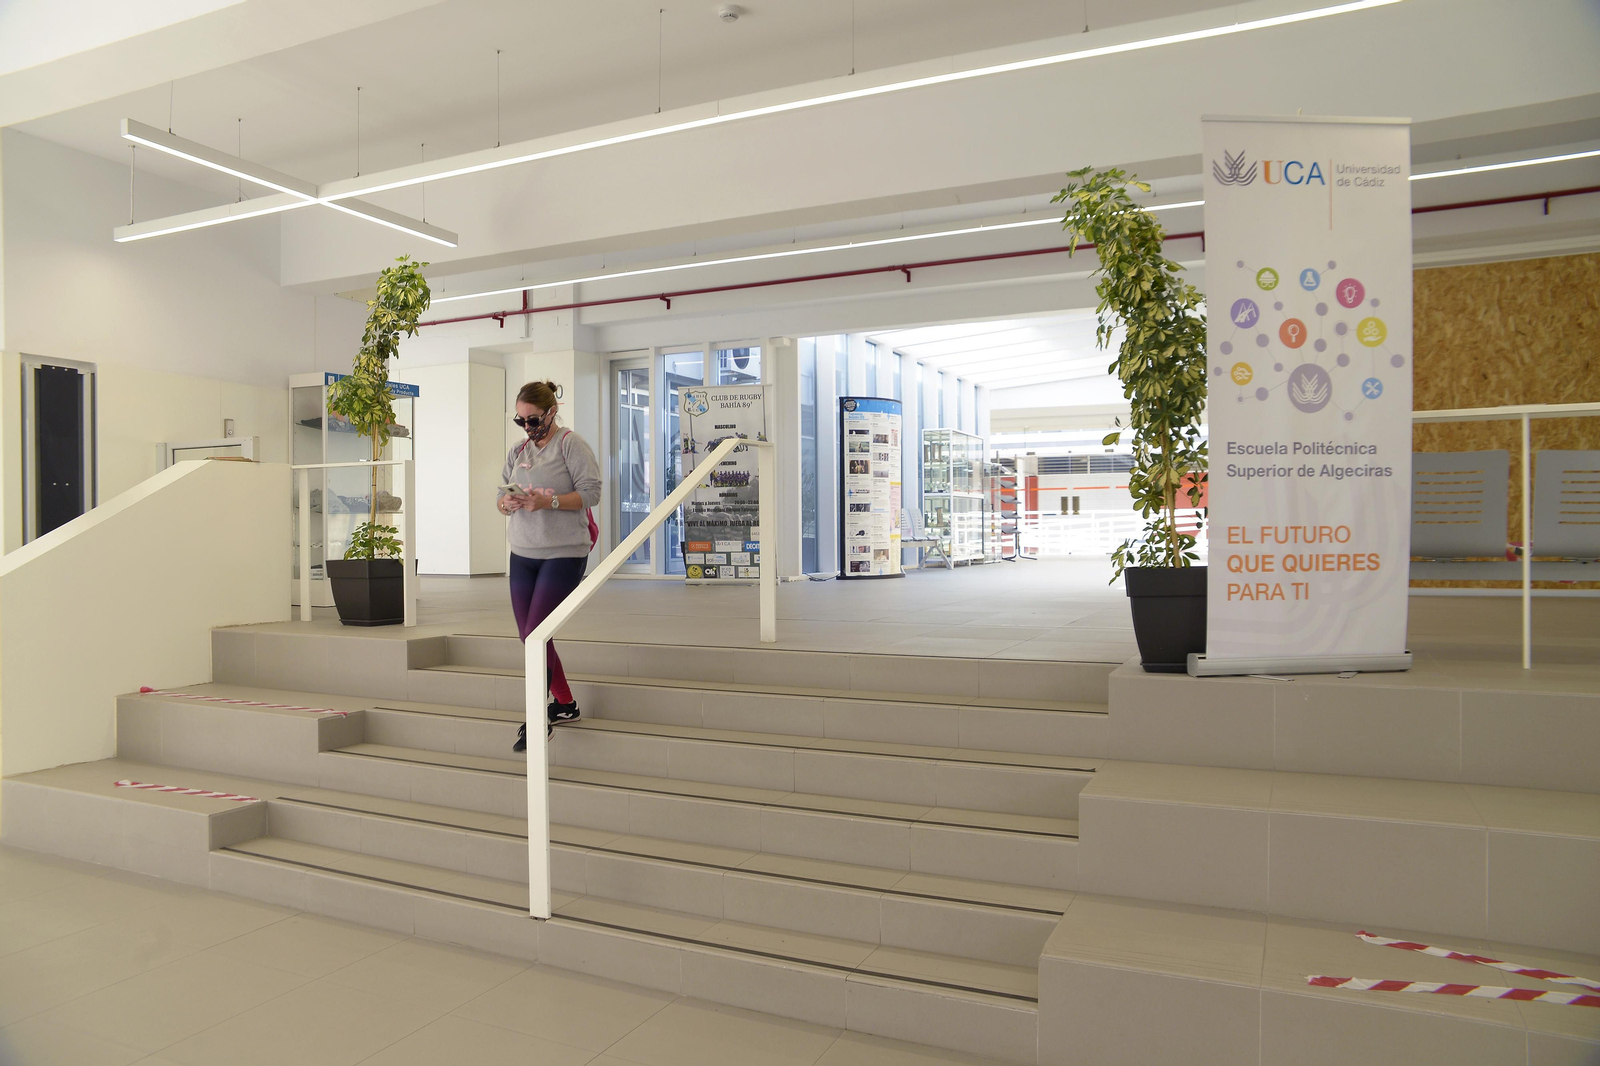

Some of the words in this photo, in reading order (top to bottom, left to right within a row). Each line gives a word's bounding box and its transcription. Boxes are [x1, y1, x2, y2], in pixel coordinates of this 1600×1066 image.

[1262, 160, 1326, 186] UCA
[1336, 164, 1401, 175] Universidad
[1336, 177, 1350, 187] de
[1354, 177, 1385, 187] Cádiz
[1227, 441, 1288, 455] Escuela
[1293, 441, 1377, 455] Politécnica
[1227, 464, 1293, 480] Superior
[1297, 464, 1315, 477] de
[1319, 464, 1393, 480] Algeciras
[1227, 526, 1253, 544] EL
[1260, 525, 1352, 544] FUTURO
[1227, 555, 1275, 574] QUE
[1282, 553, 1381, 573] QUIERES
[1227, 583, 1285, 601] PARA
[1291, 582, 1309, 600] TI
